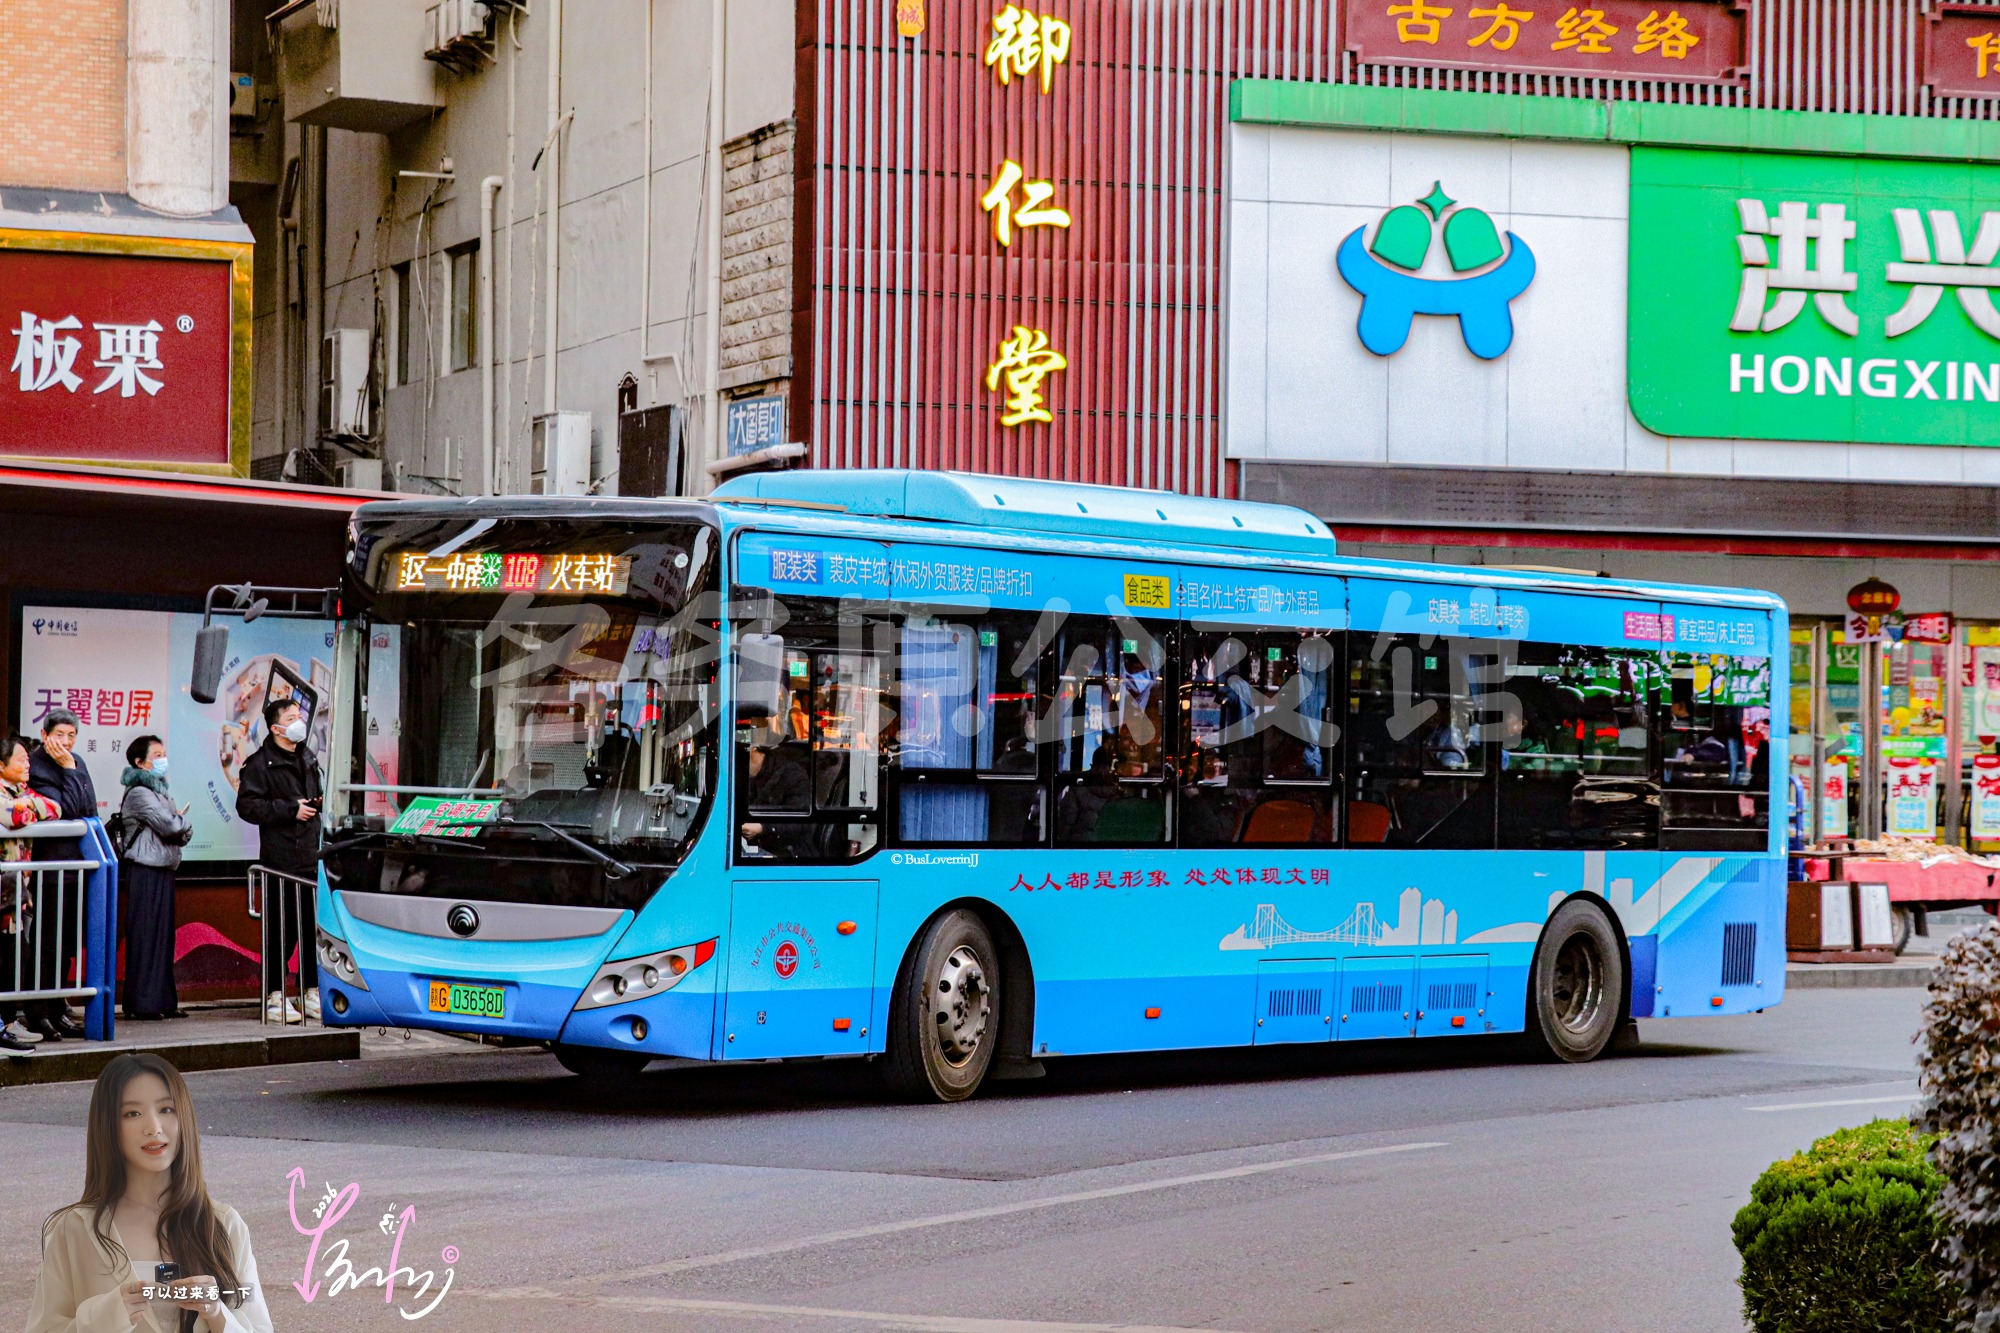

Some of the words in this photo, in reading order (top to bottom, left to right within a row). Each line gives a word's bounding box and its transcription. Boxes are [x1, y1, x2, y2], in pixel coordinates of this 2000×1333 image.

[1386, 0, 1699, 59] 古方经络
[981, 5, 1072, 427] 御仁堂
[1729, 198, 2000, 338] 洪兴
[11, 311, 164, 397] 板栗
[1729, 352, 2000, 402] HONGXIN
[504, 554, 539, 588] 108
[549, 554, 617, 590] 火车站
[772, 550, 817, 583] 服装类
[1127, 577, 1164, 606] 食品类
[1175, 581, 1320, 615] 全国名优土特产品/中外商品
[1428, 598, 1460, 625] 皮具类
[1626, 613, 1674, 641] 生活用品类
[32, 688, 154, 727] 天翼智屏
[431, 802, 494, 820] 空调开启
[1009, 869, 1170, 892] 人人都是形象
[1184, 868, 1330, 888] 处处体现文明
